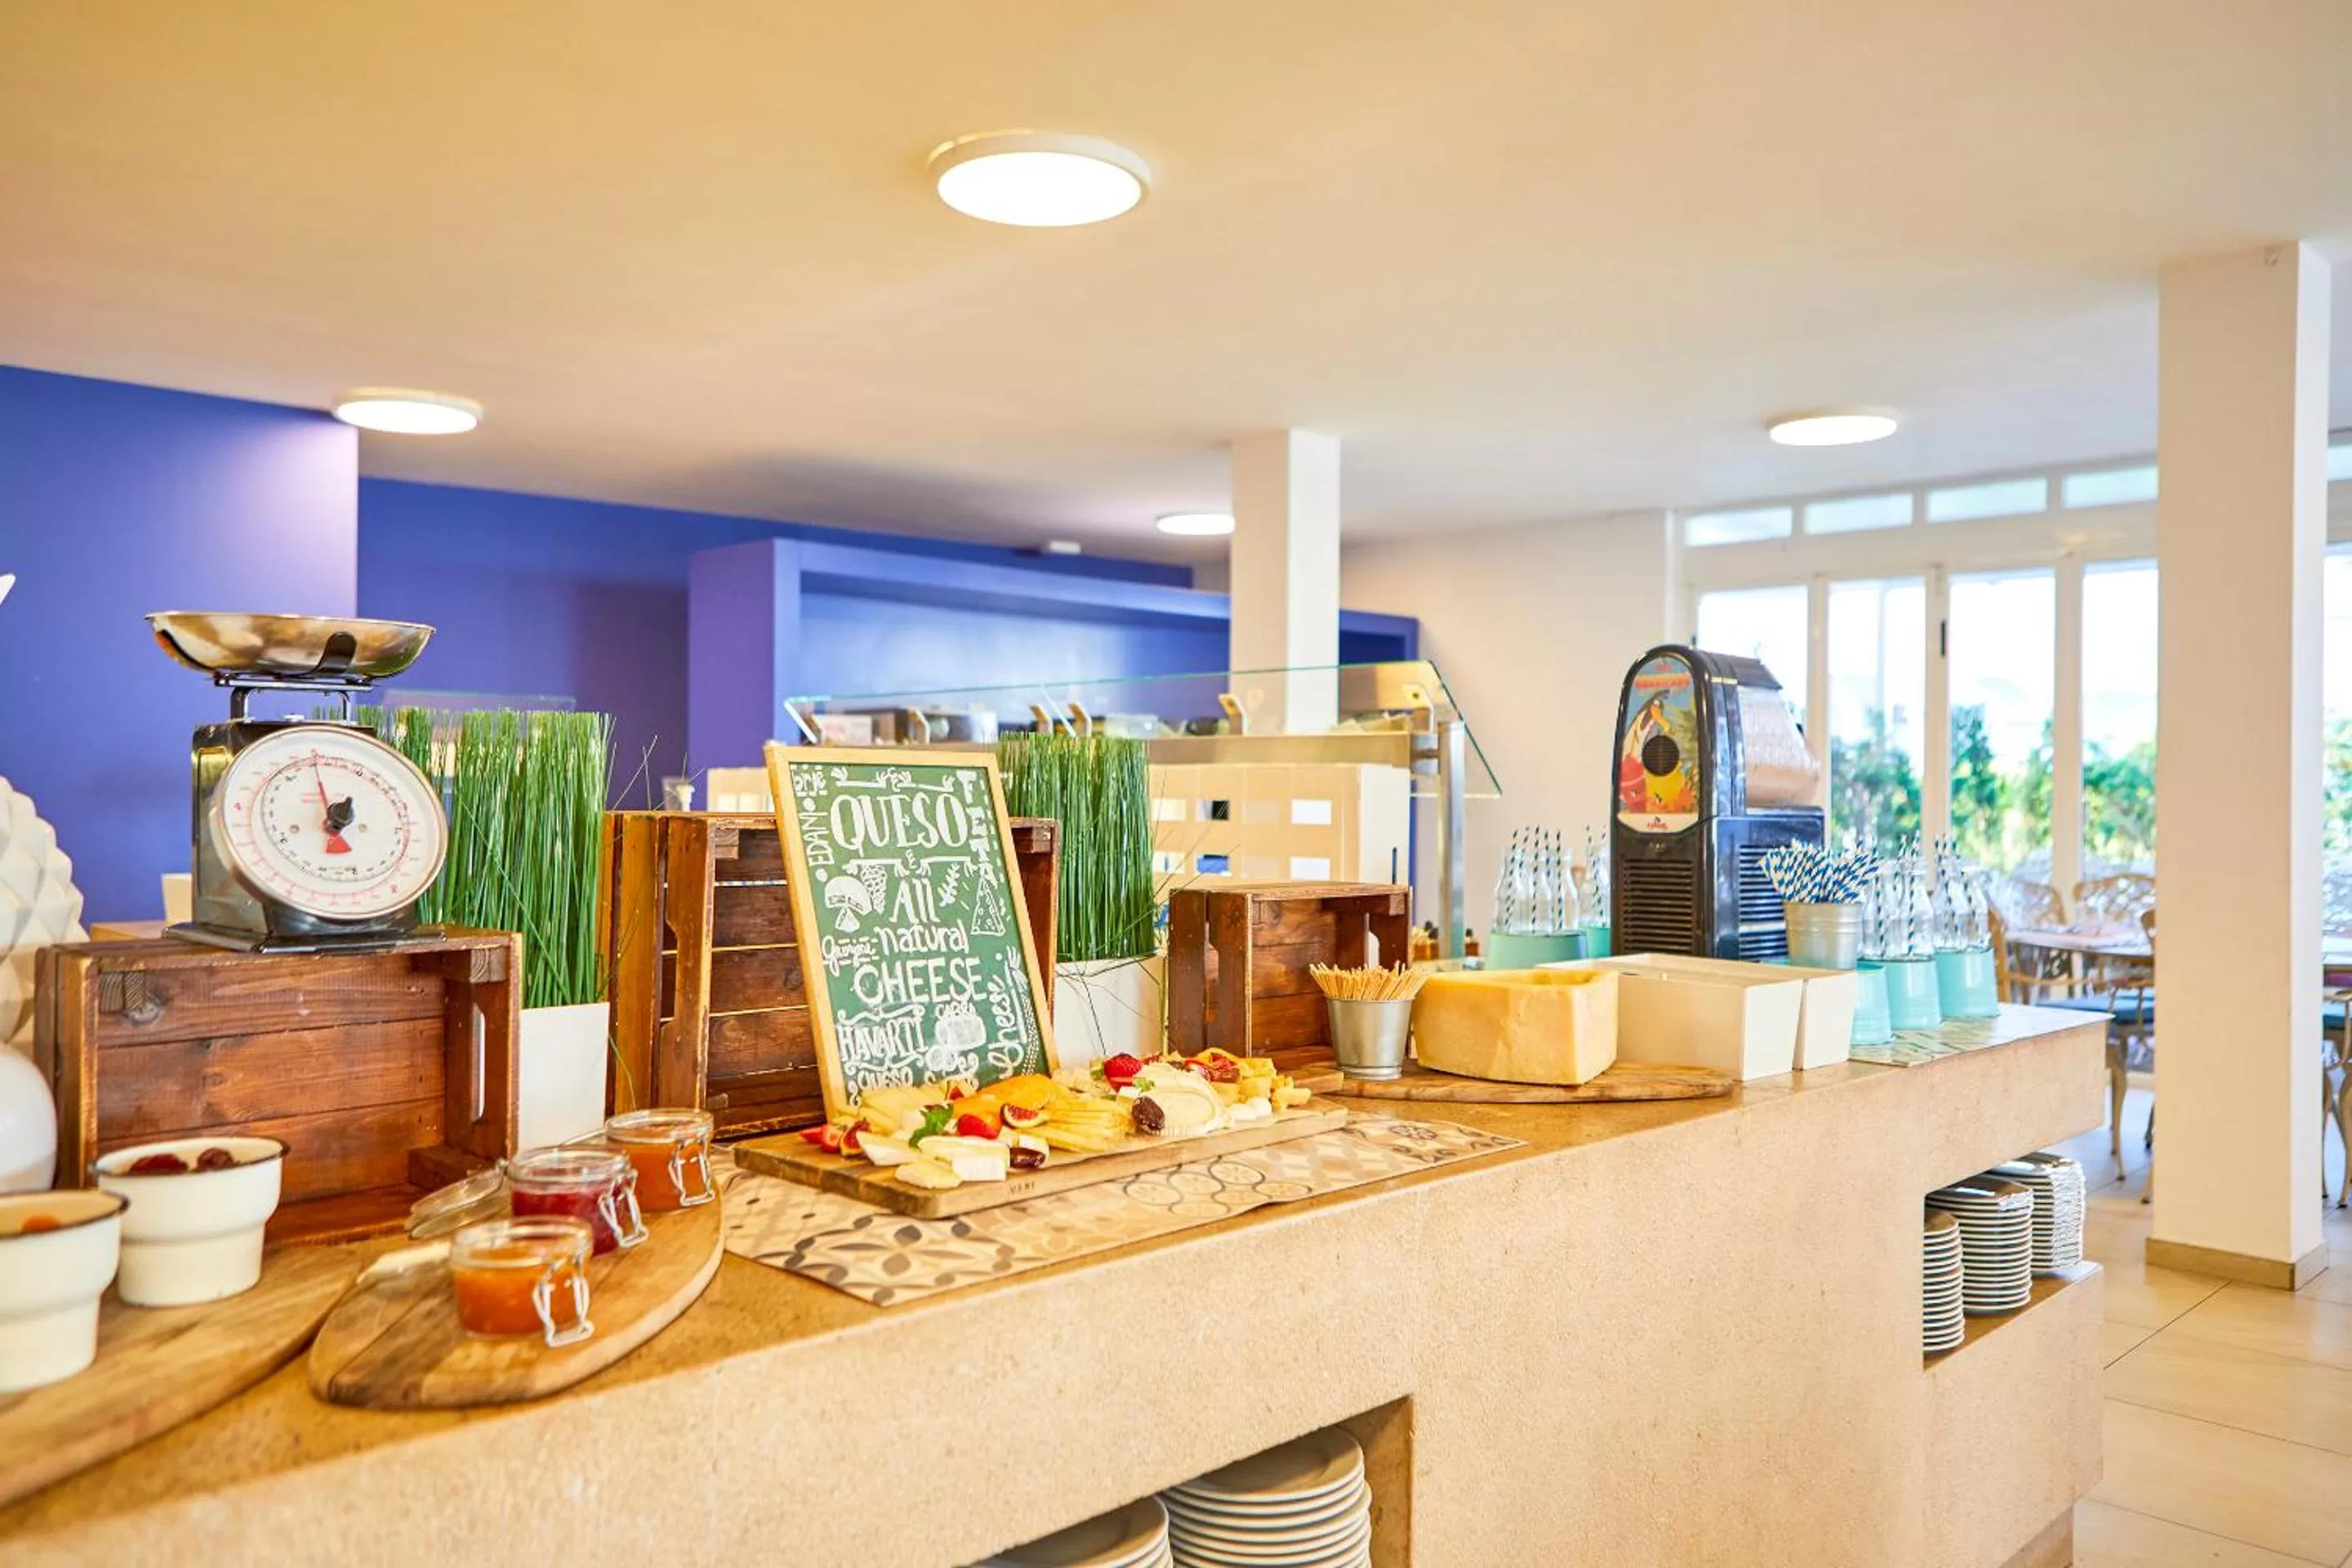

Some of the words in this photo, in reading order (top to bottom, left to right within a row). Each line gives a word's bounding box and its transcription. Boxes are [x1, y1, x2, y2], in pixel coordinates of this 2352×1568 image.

[830, 793, 969, 858] QUESO
[889, 879, 941, 924] All
[874, 919, 969, 955] natural
[853, 956, 987, 1004] CHEESE
[836, 1016, 929, 1062] HAVARTI
